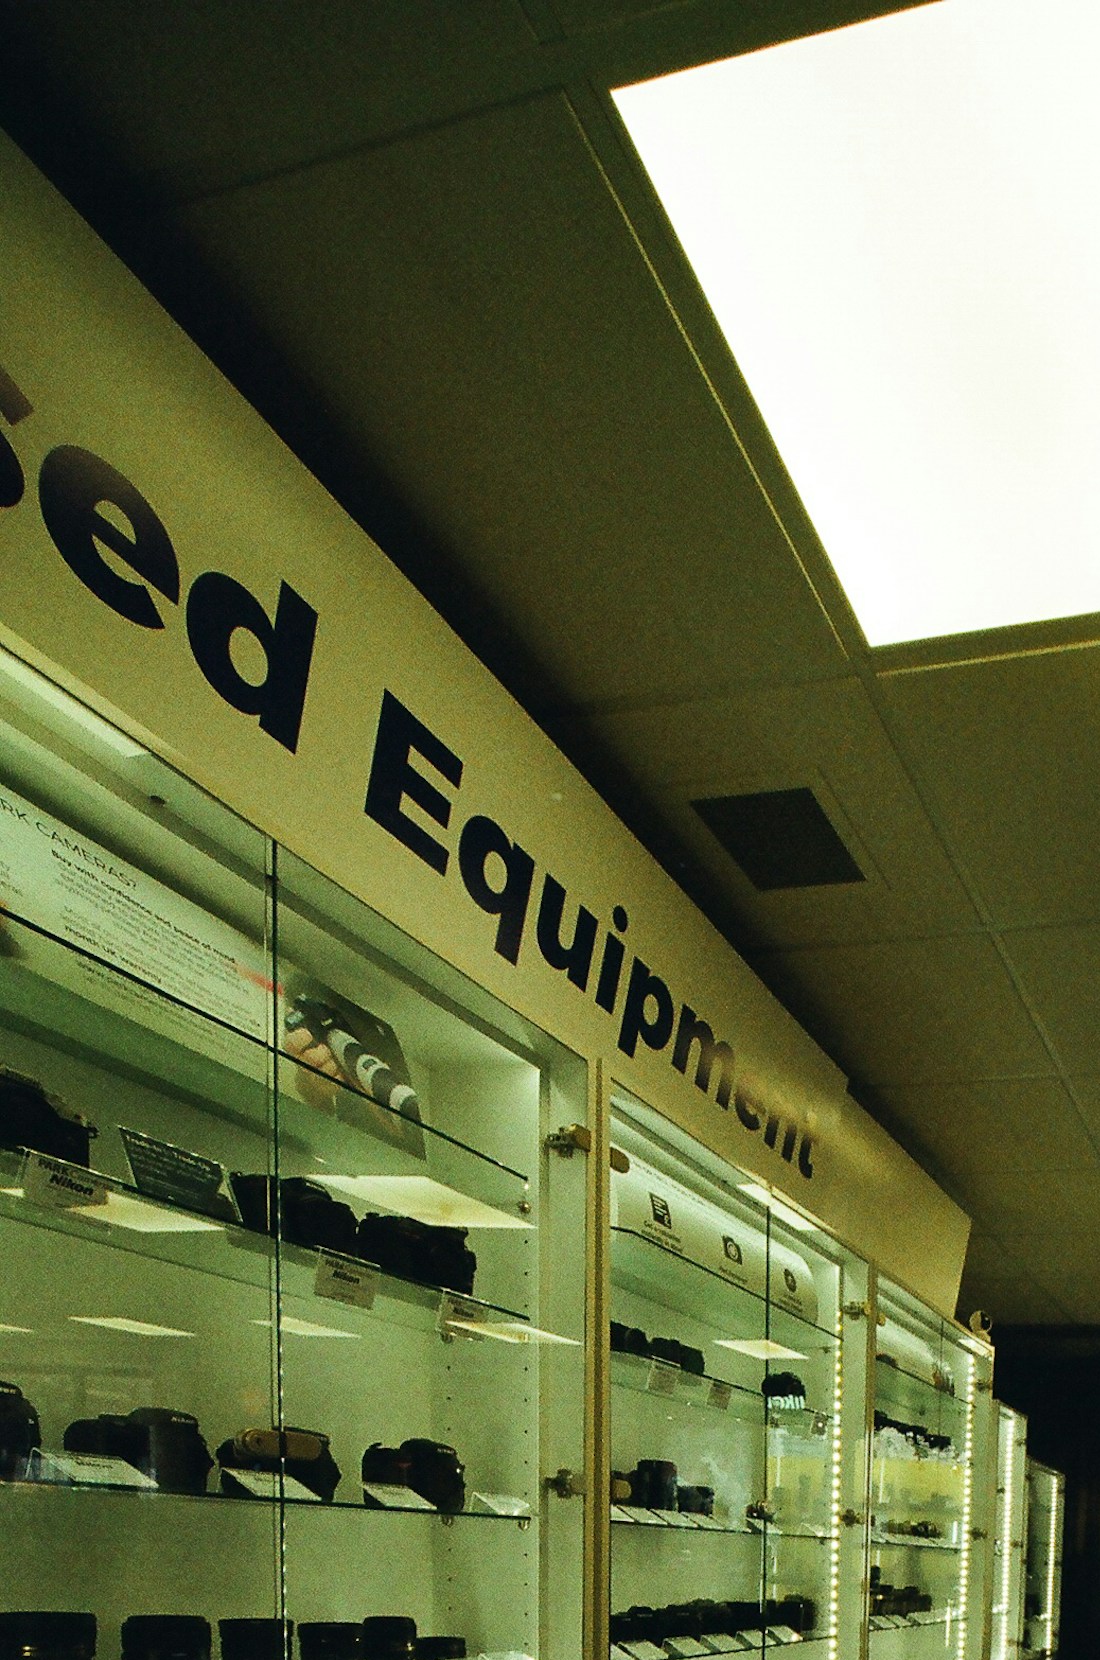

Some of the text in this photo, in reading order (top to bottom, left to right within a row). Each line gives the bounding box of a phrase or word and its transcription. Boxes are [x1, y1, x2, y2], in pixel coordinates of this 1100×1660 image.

[36, 822, 137, 888] CAMERAS?
[51, 849, 72, 867] Buy
[74, 862, 98, 882] with
[100, 879, 152, 917] confidence
[364, 687, 816, 1179] Equipment
[50, 1173, 94, 1196] Nikon
